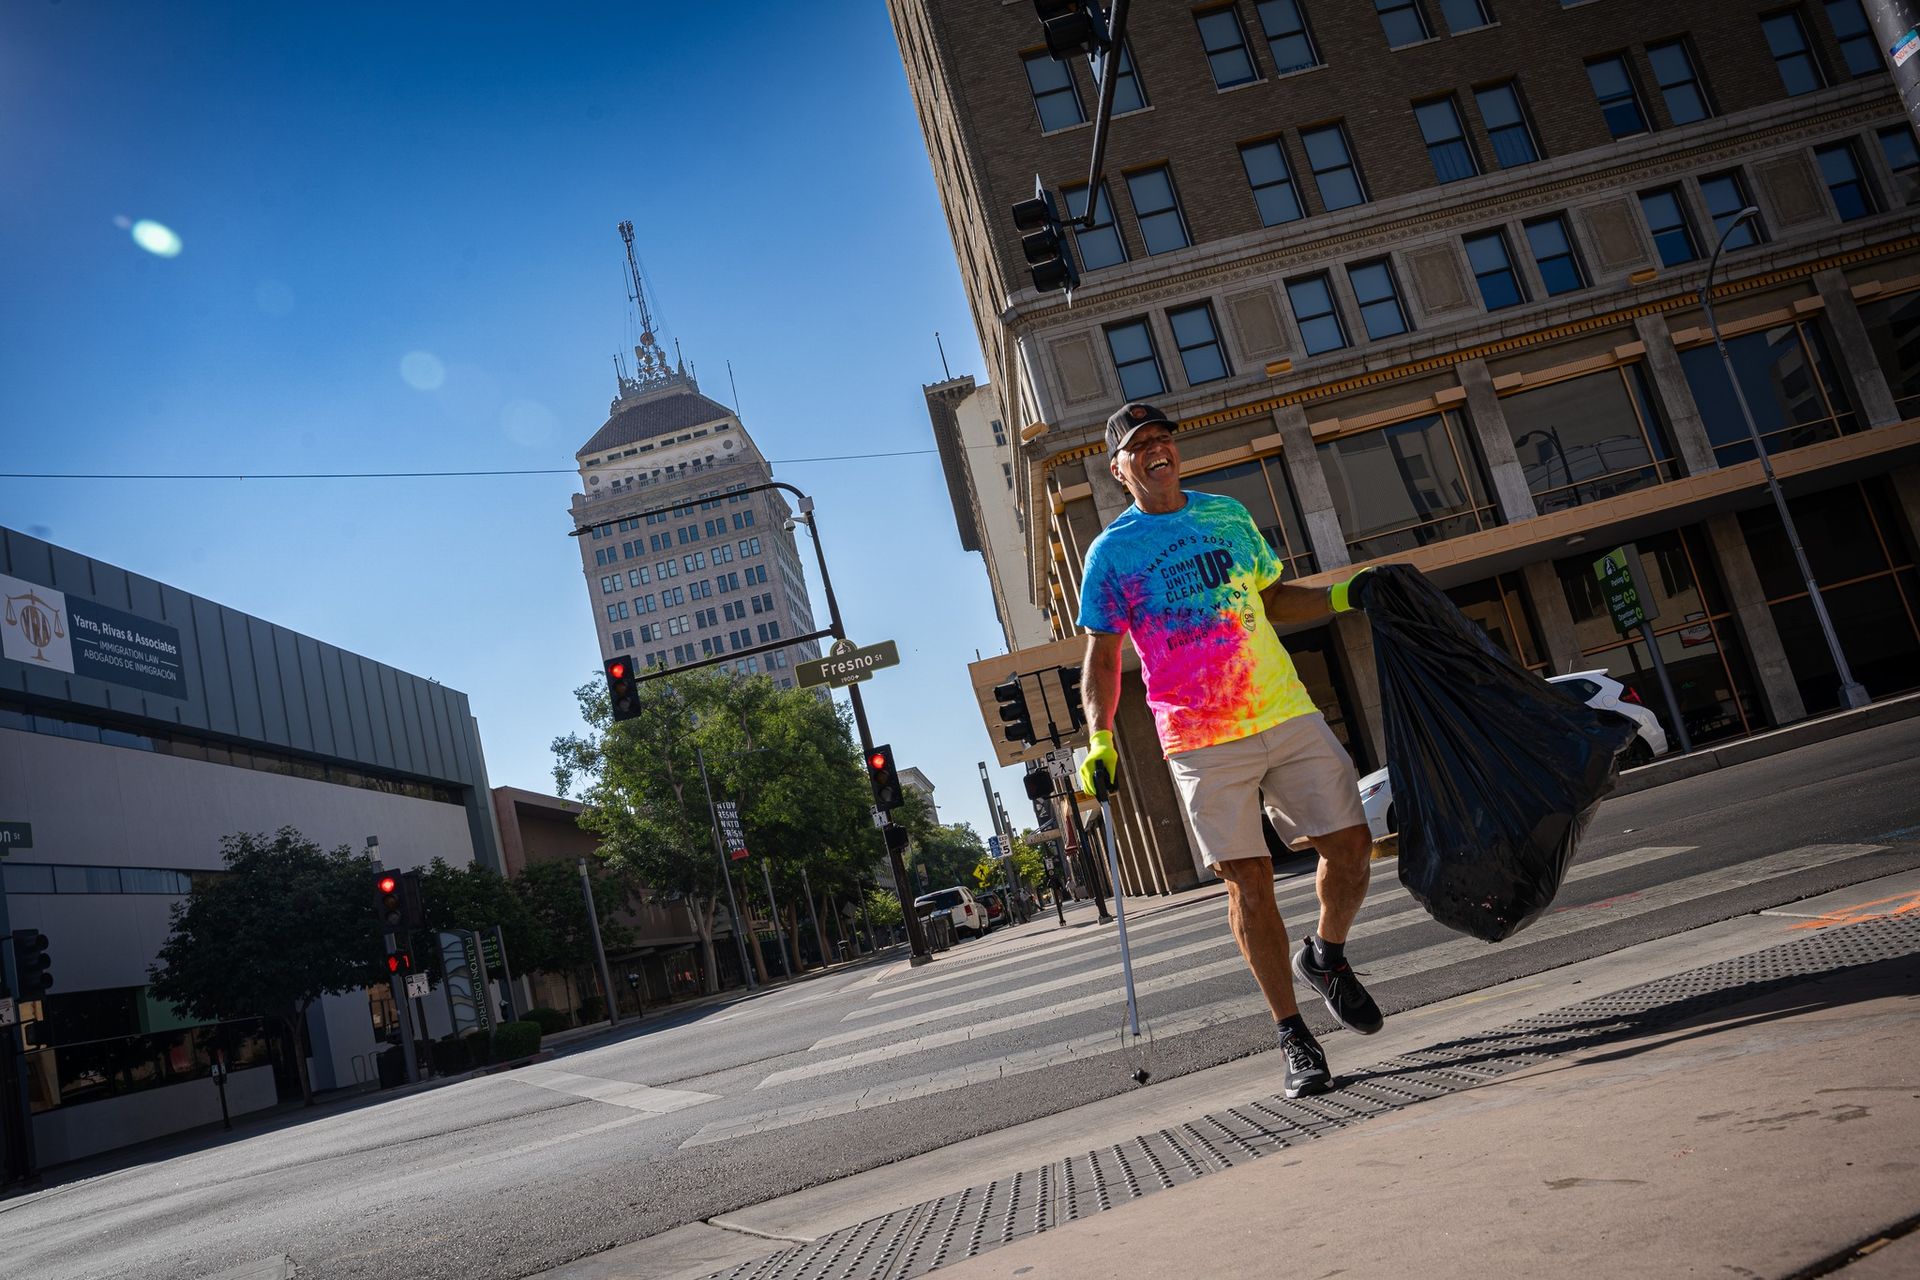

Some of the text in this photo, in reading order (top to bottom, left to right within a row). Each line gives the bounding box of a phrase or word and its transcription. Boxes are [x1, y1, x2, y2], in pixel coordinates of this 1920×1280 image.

[1147, 535, 1233, 573] MAYOR'S 2023
[1161, 559, 1196, 579] COMM
[1165, 570, 1199, 590] UNITY
[1194, 549, 1234, 589] UP
[1166, 583, 1204, 603] CLEAN
[73, 614, 177, 655] Yarra, Rivas & Associates
[99, 641, 160, 664] IMMIGRATION LAW
[84, 649, 177, 681] ABOGADOS DE INMIGRACIÓN
[820, 654, 883, 678] Fresno St
[13, 832, 21, 840] St
[1003, 845, 1010, 854] 5
[465, 937, 477, 980] FULTON
[474, 982, 489, 1031] DISTRICT
